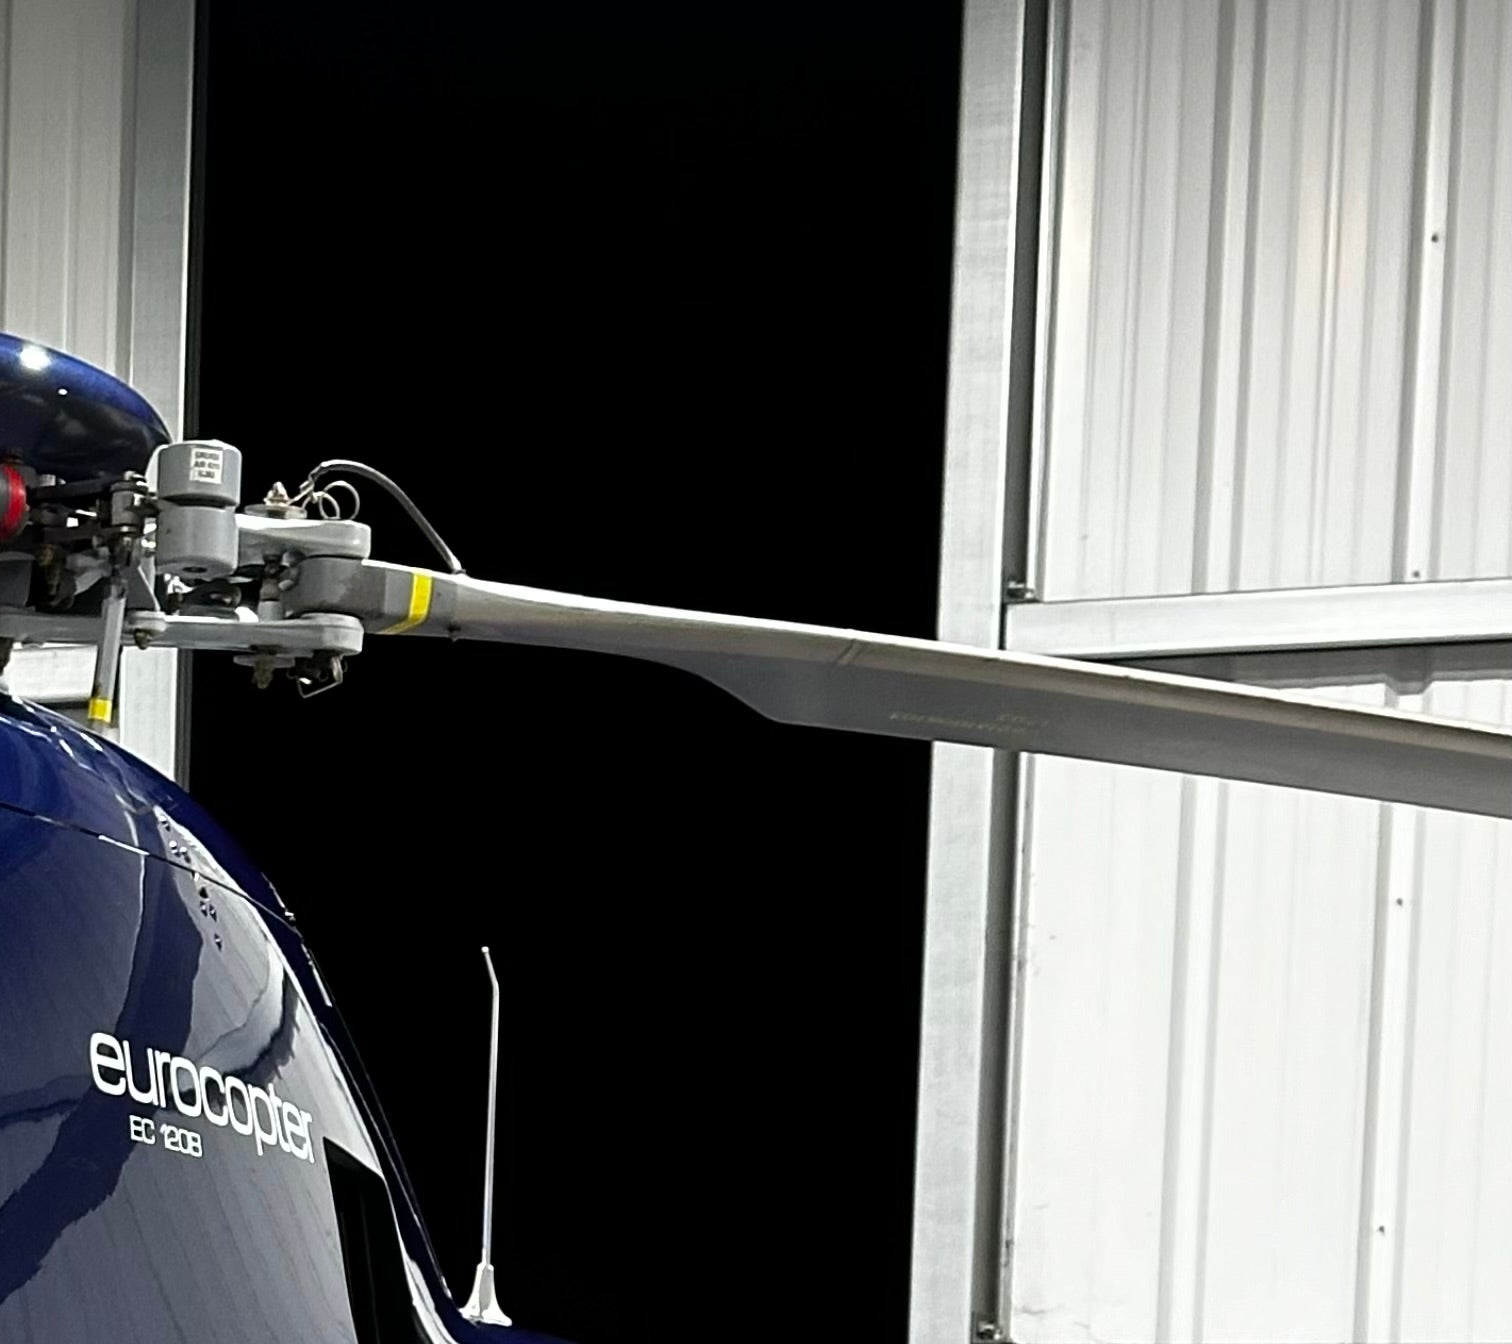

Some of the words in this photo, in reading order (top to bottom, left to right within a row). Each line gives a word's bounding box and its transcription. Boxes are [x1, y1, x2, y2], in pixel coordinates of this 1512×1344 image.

[90, 1032, 315, 1163] eurocopter
[129, 1115, 156, 1145] EC
[159, 1123, 203, 1158] 120B
